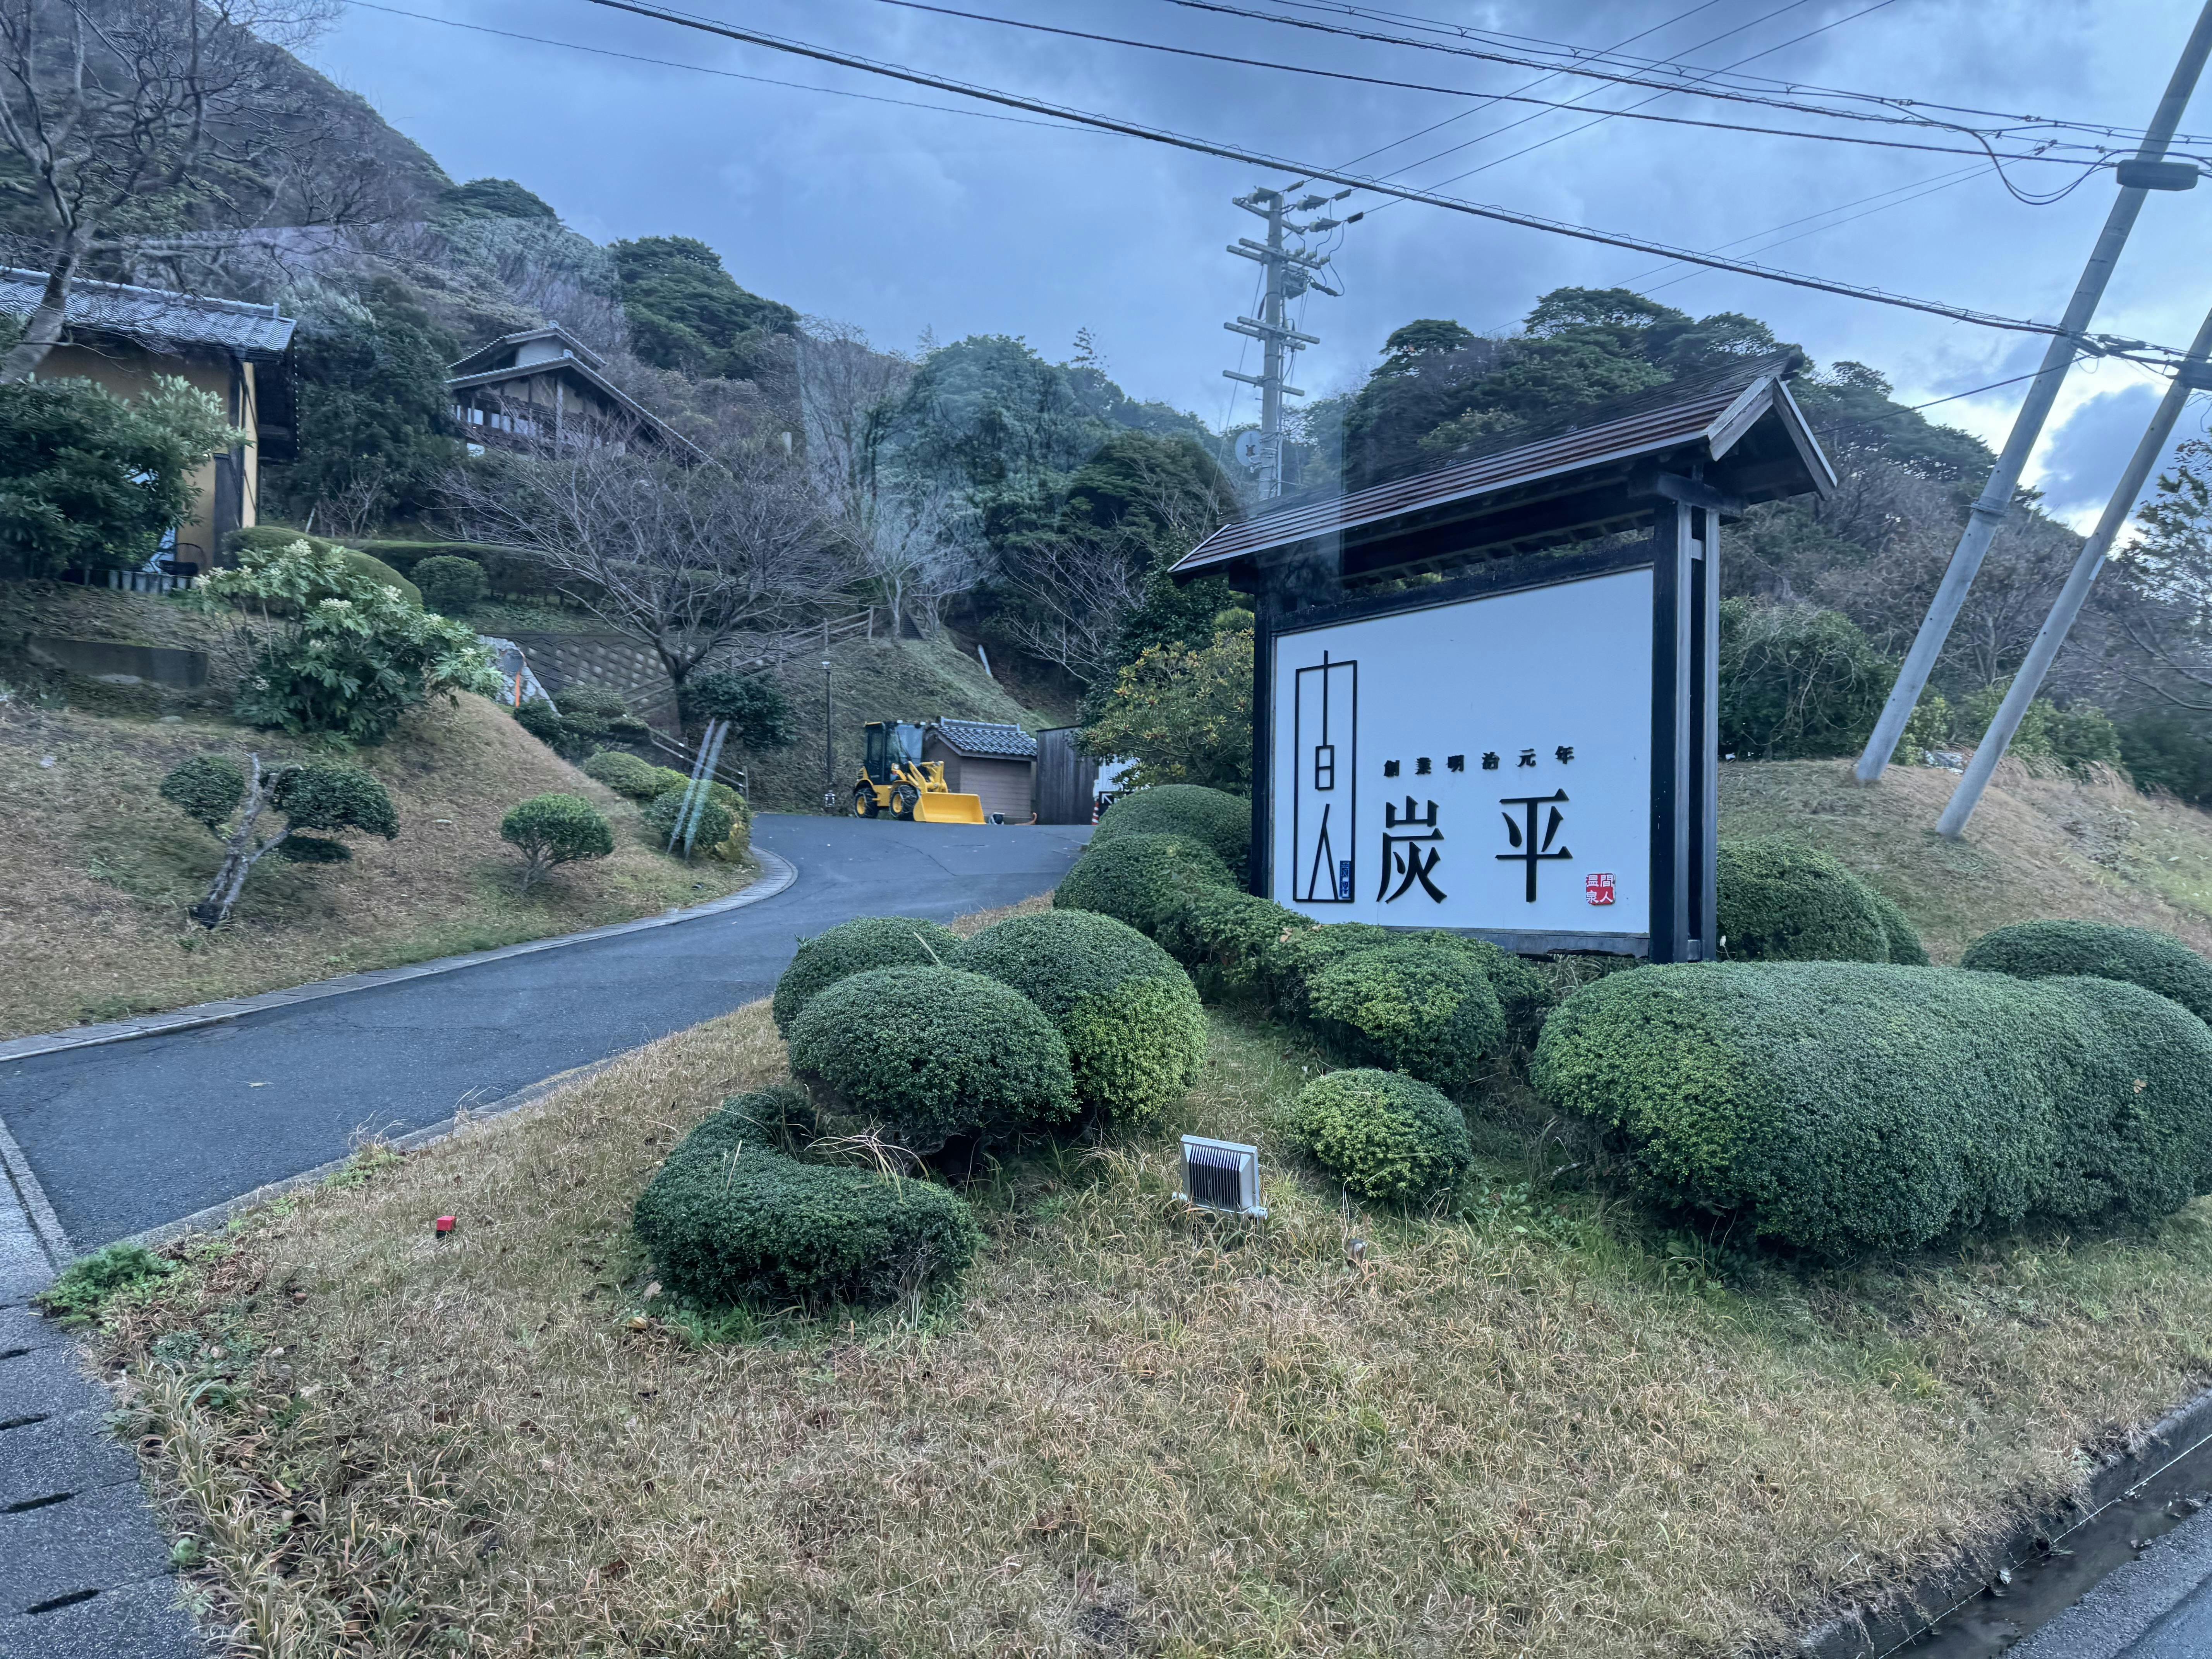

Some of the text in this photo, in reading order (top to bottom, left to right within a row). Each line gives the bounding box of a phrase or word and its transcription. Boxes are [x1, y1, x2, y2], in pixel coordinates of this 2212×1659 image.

[1384, 746, 1574, 777] 創業明治元年
[1376, 789, 1572, 903] 炭平
